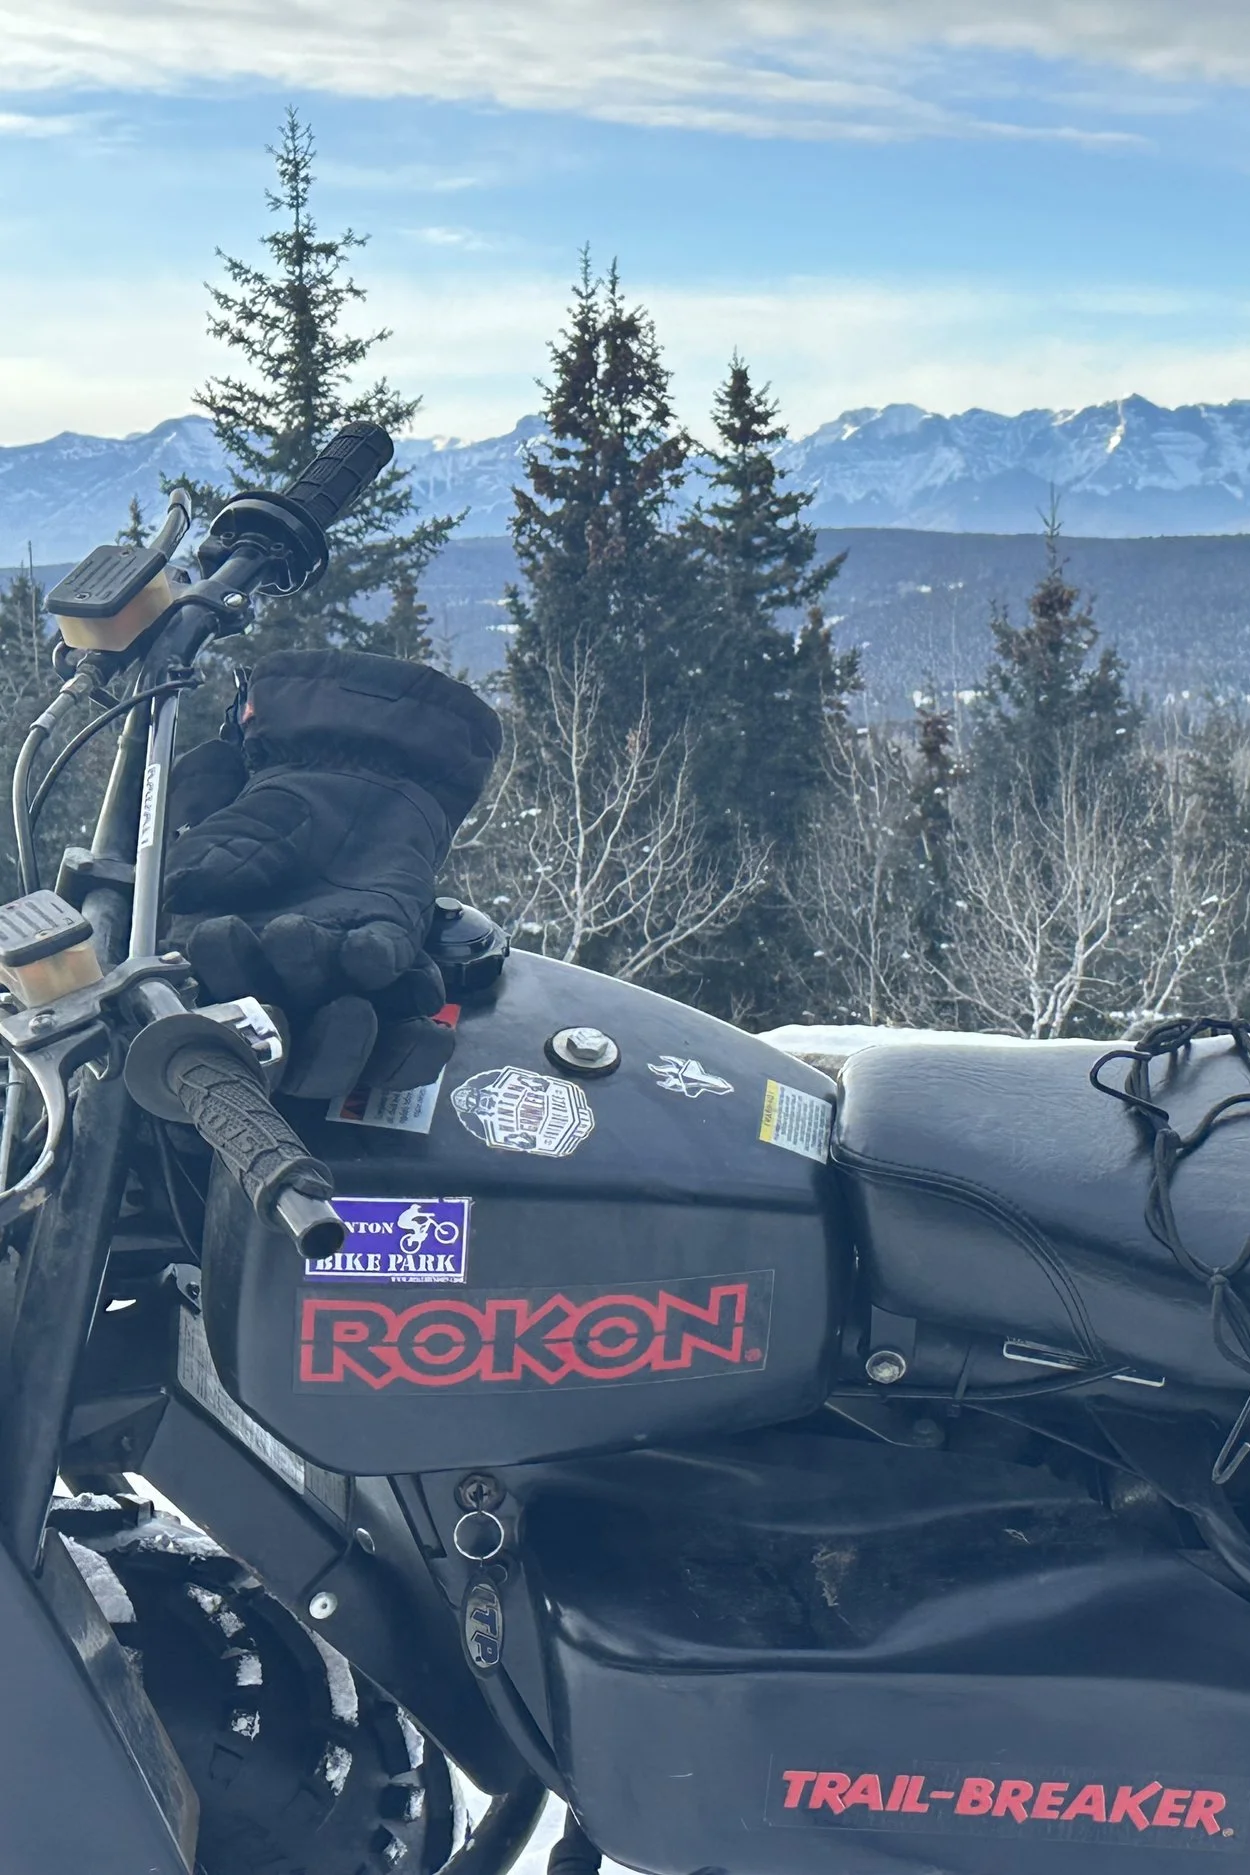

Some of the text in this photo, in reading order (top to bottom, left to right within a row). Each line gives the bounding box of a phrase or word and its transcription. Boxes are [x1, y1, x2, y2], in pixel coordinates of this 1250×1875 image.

[344, 1221, 394, 1234] NTON
[316, 1252, 455, 1272] BIKE PARK
[300, 1284, 747, 1390] ROKON
[782, 1769, 1228, 1836] TRAIL-BREAKER
